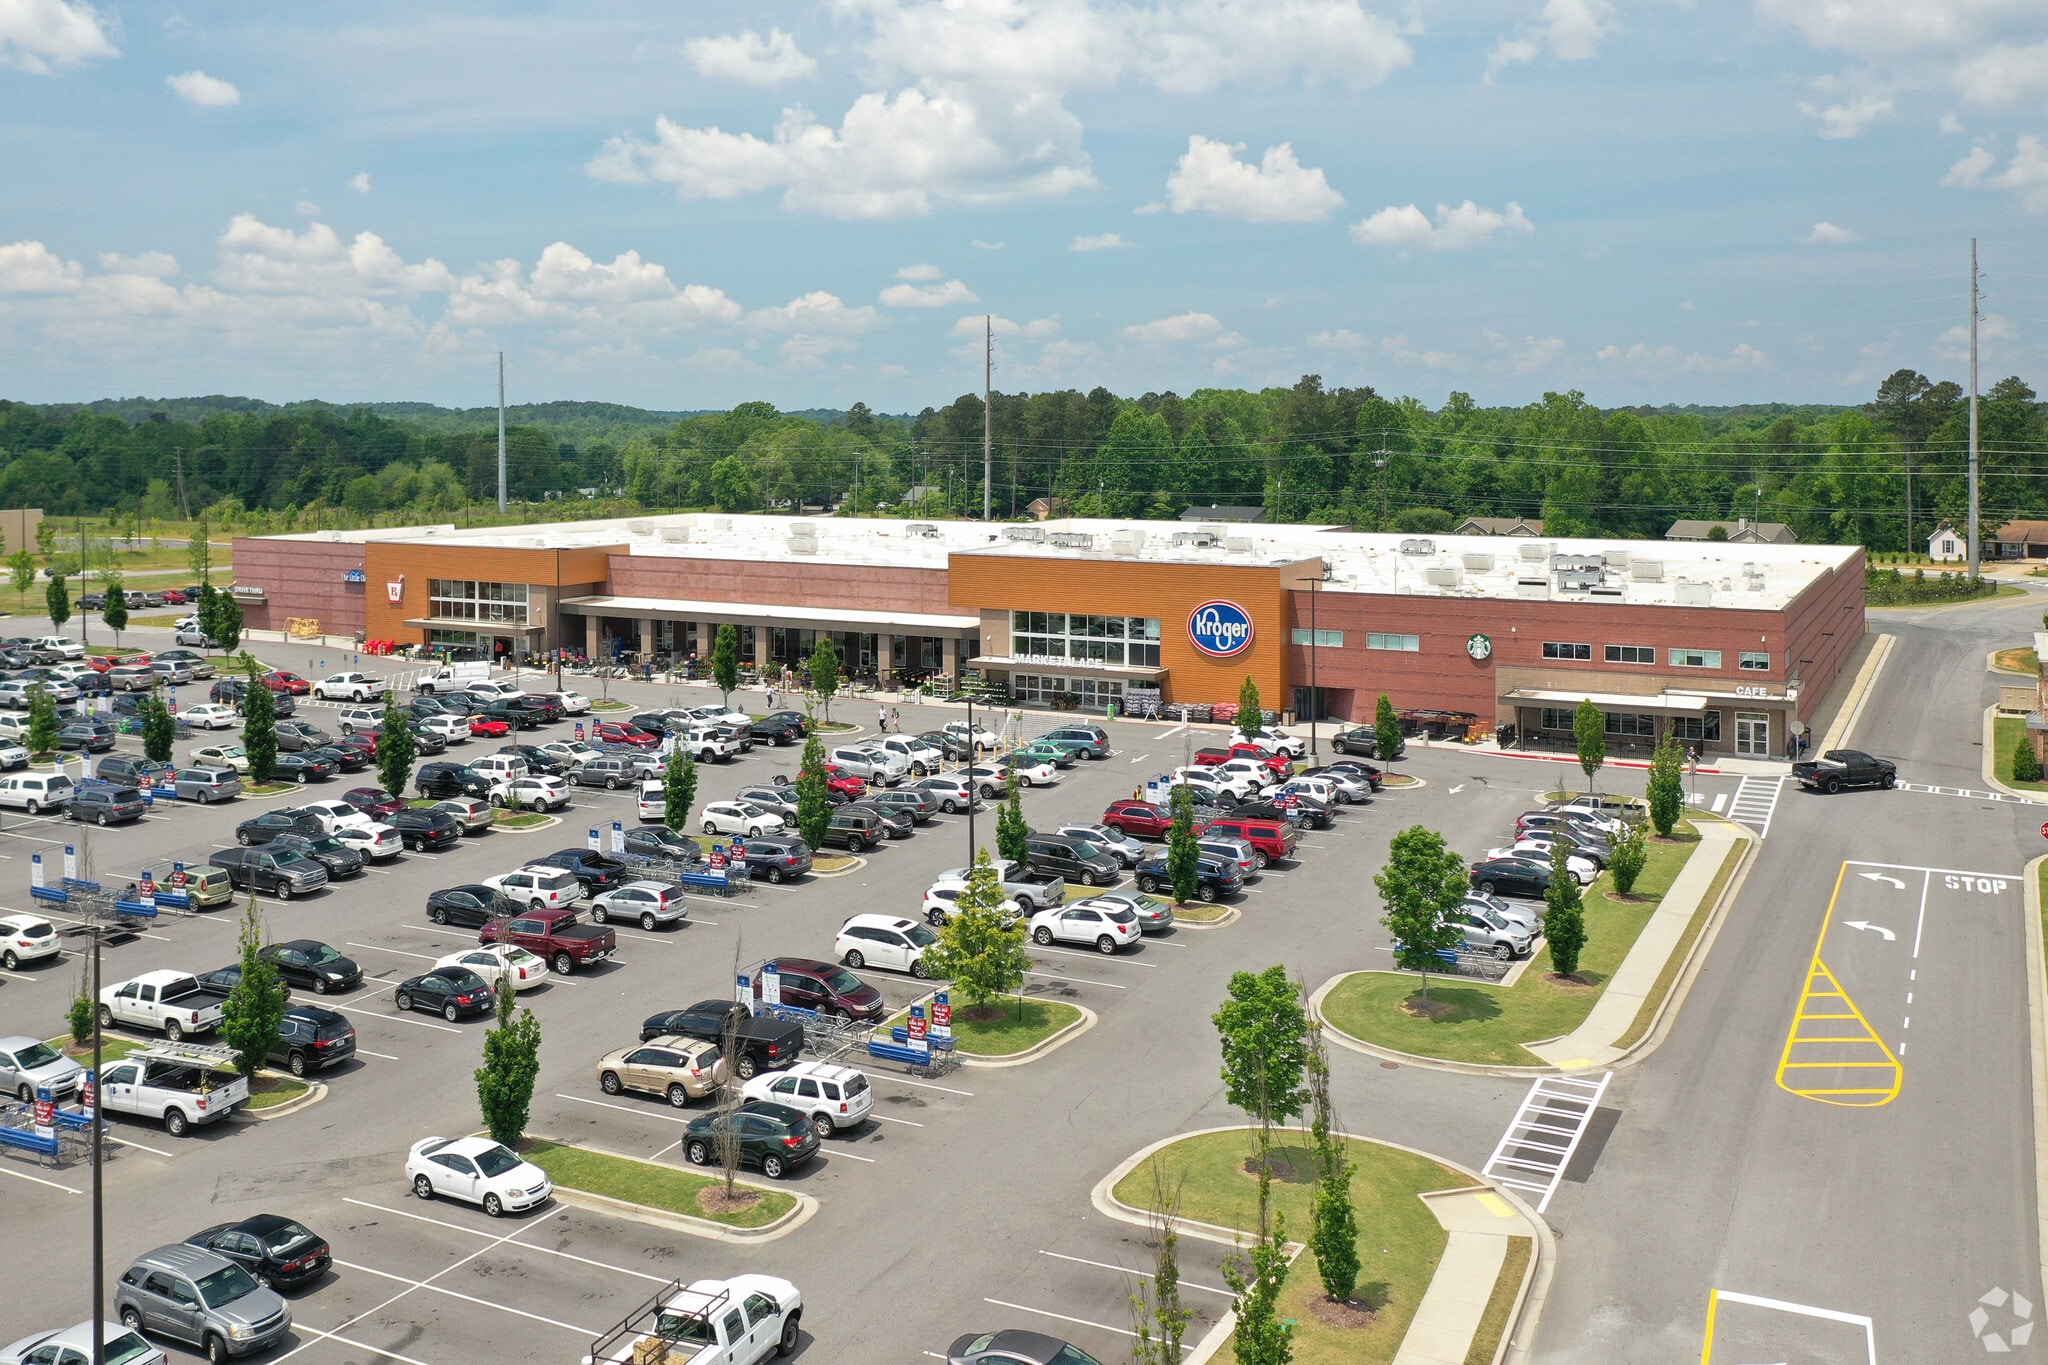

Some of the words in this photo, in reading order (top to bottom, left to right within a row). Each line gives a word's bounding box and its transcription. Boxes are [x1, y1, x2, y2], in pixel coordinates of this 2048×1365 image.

[250, 587, 263, 595] THRU
[1196, 608, 1248, 650] Kroger
[1014, 653, 1103, 669] MARKETPLACE
[1736, 686, 1767, 696] CAFE
[1944, 875, 2007, 895] STOP
